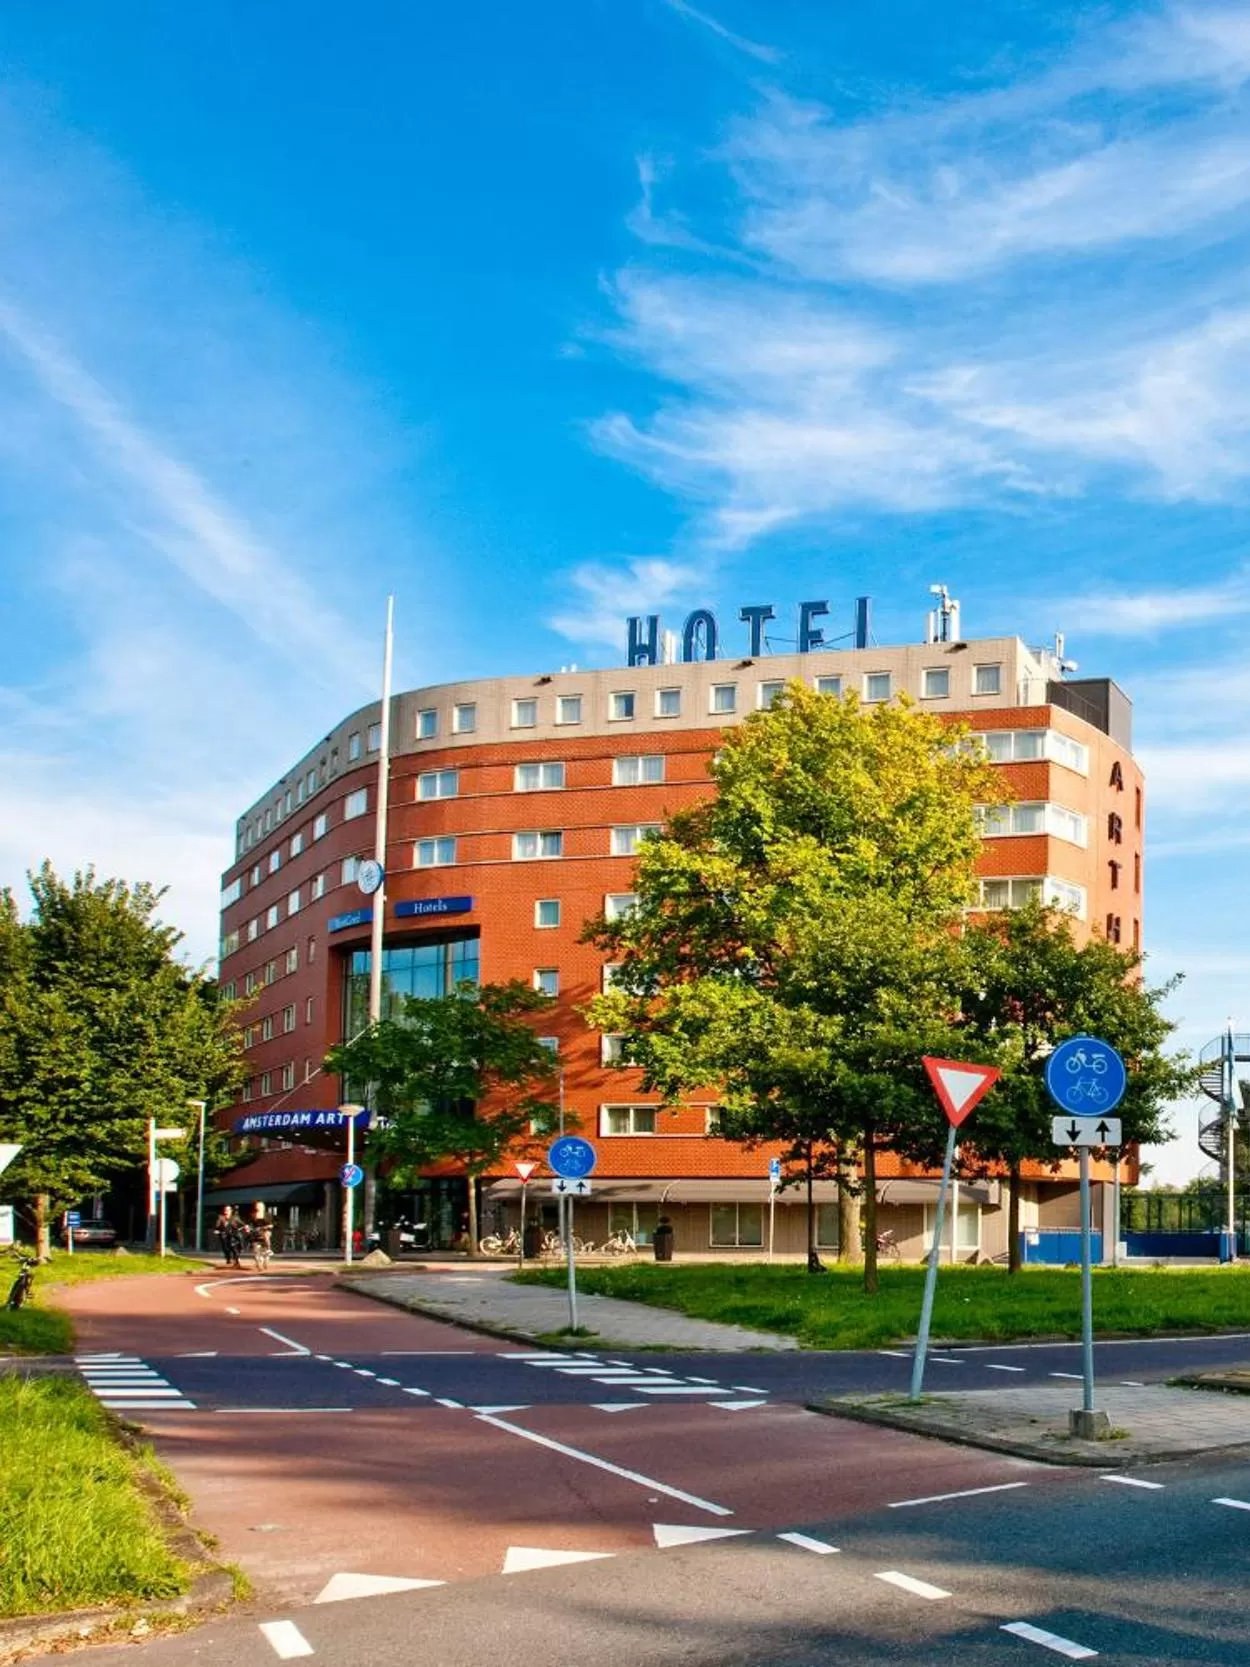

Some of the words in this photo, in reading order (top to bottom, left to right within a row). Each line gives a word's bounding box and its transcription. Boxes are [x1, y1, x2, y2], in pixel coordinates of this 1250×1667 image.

[413, 899, 448, 914] Hotels
[243, 1112, 311, 1130] AMSTERDAM
[315, 1112, 345, 1125] ART
